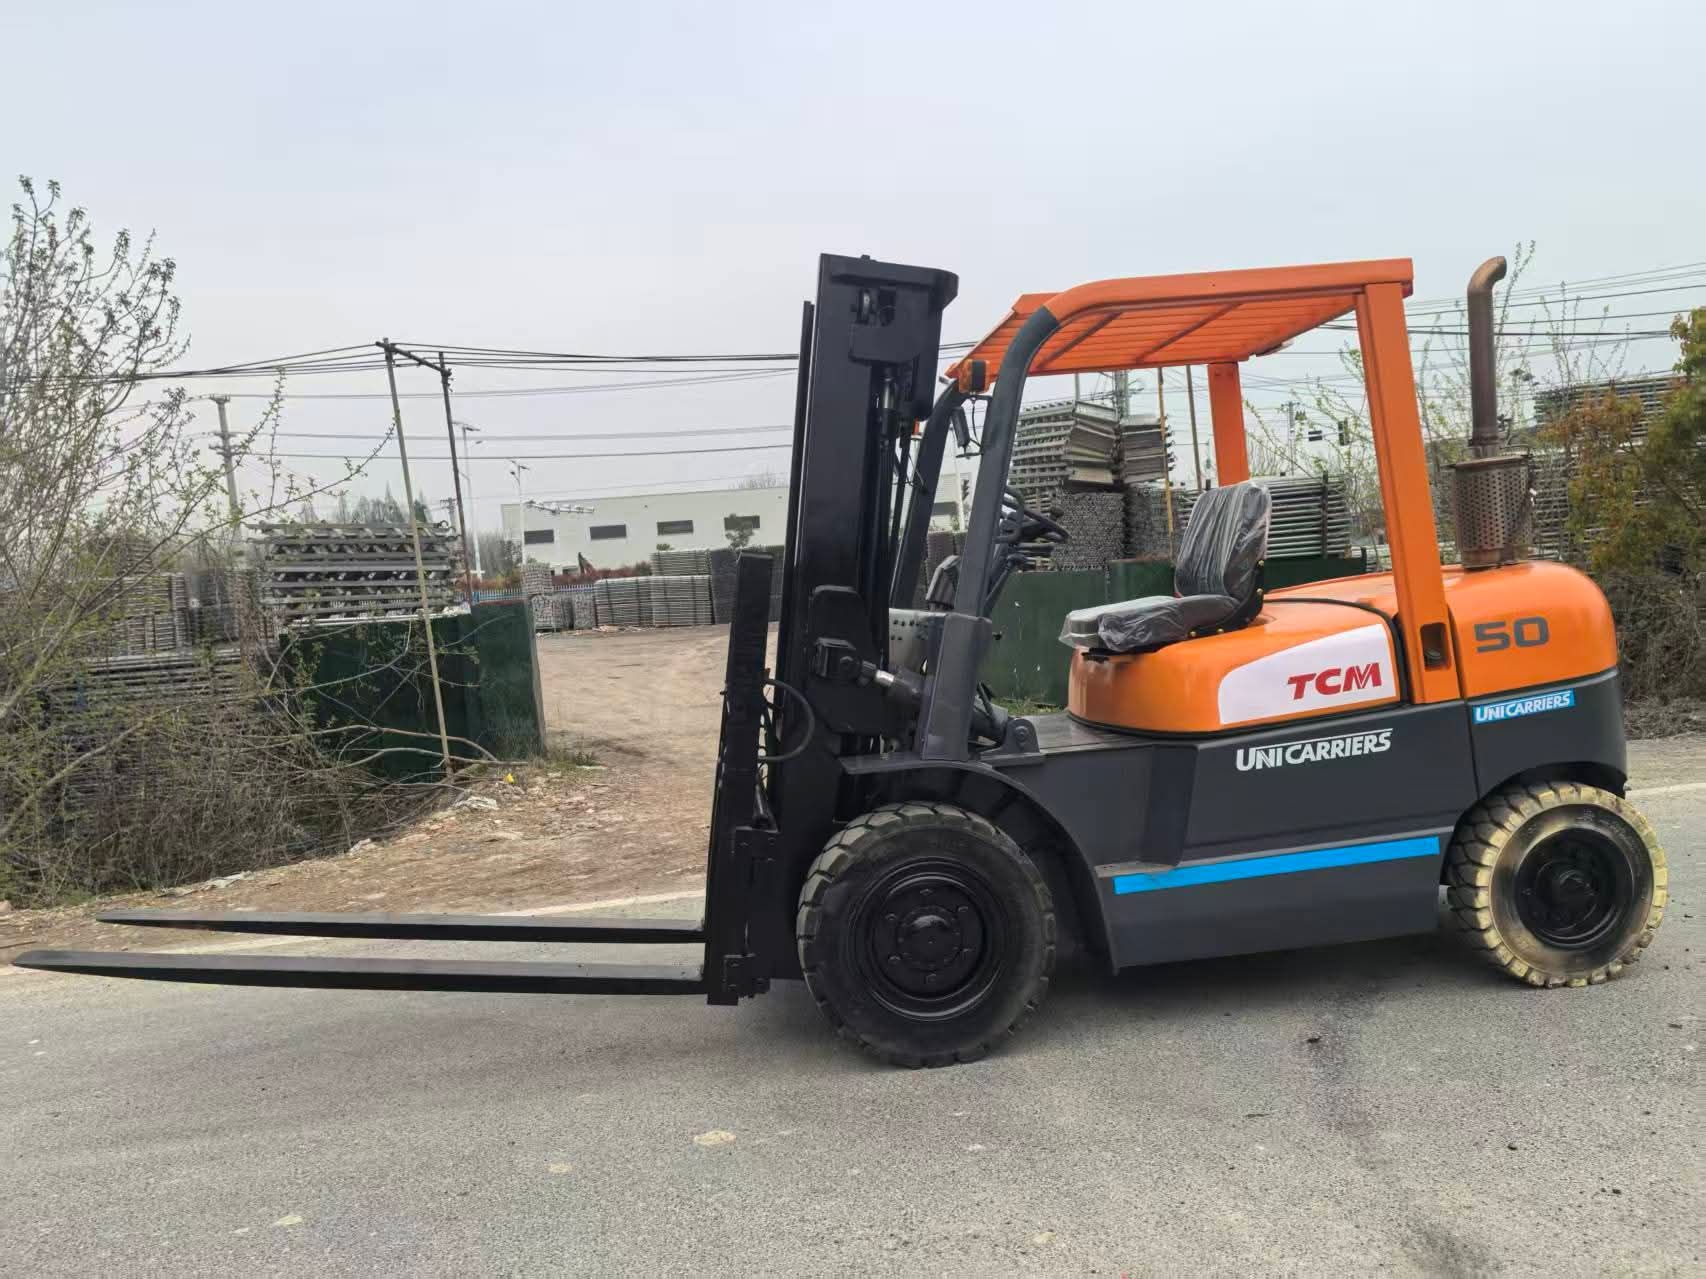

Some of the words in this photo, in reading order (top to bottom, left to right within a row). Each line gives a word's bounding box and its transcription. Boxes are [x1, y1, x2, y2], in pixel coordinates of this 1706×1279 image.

[1474, 616, 1549, 652] 50
[1288, 662, 1382, 700] TCM
[1475, 691, 1572, 722] UNICARRIERS
[1236, 728, 1393, 771] UNICARRIERS
